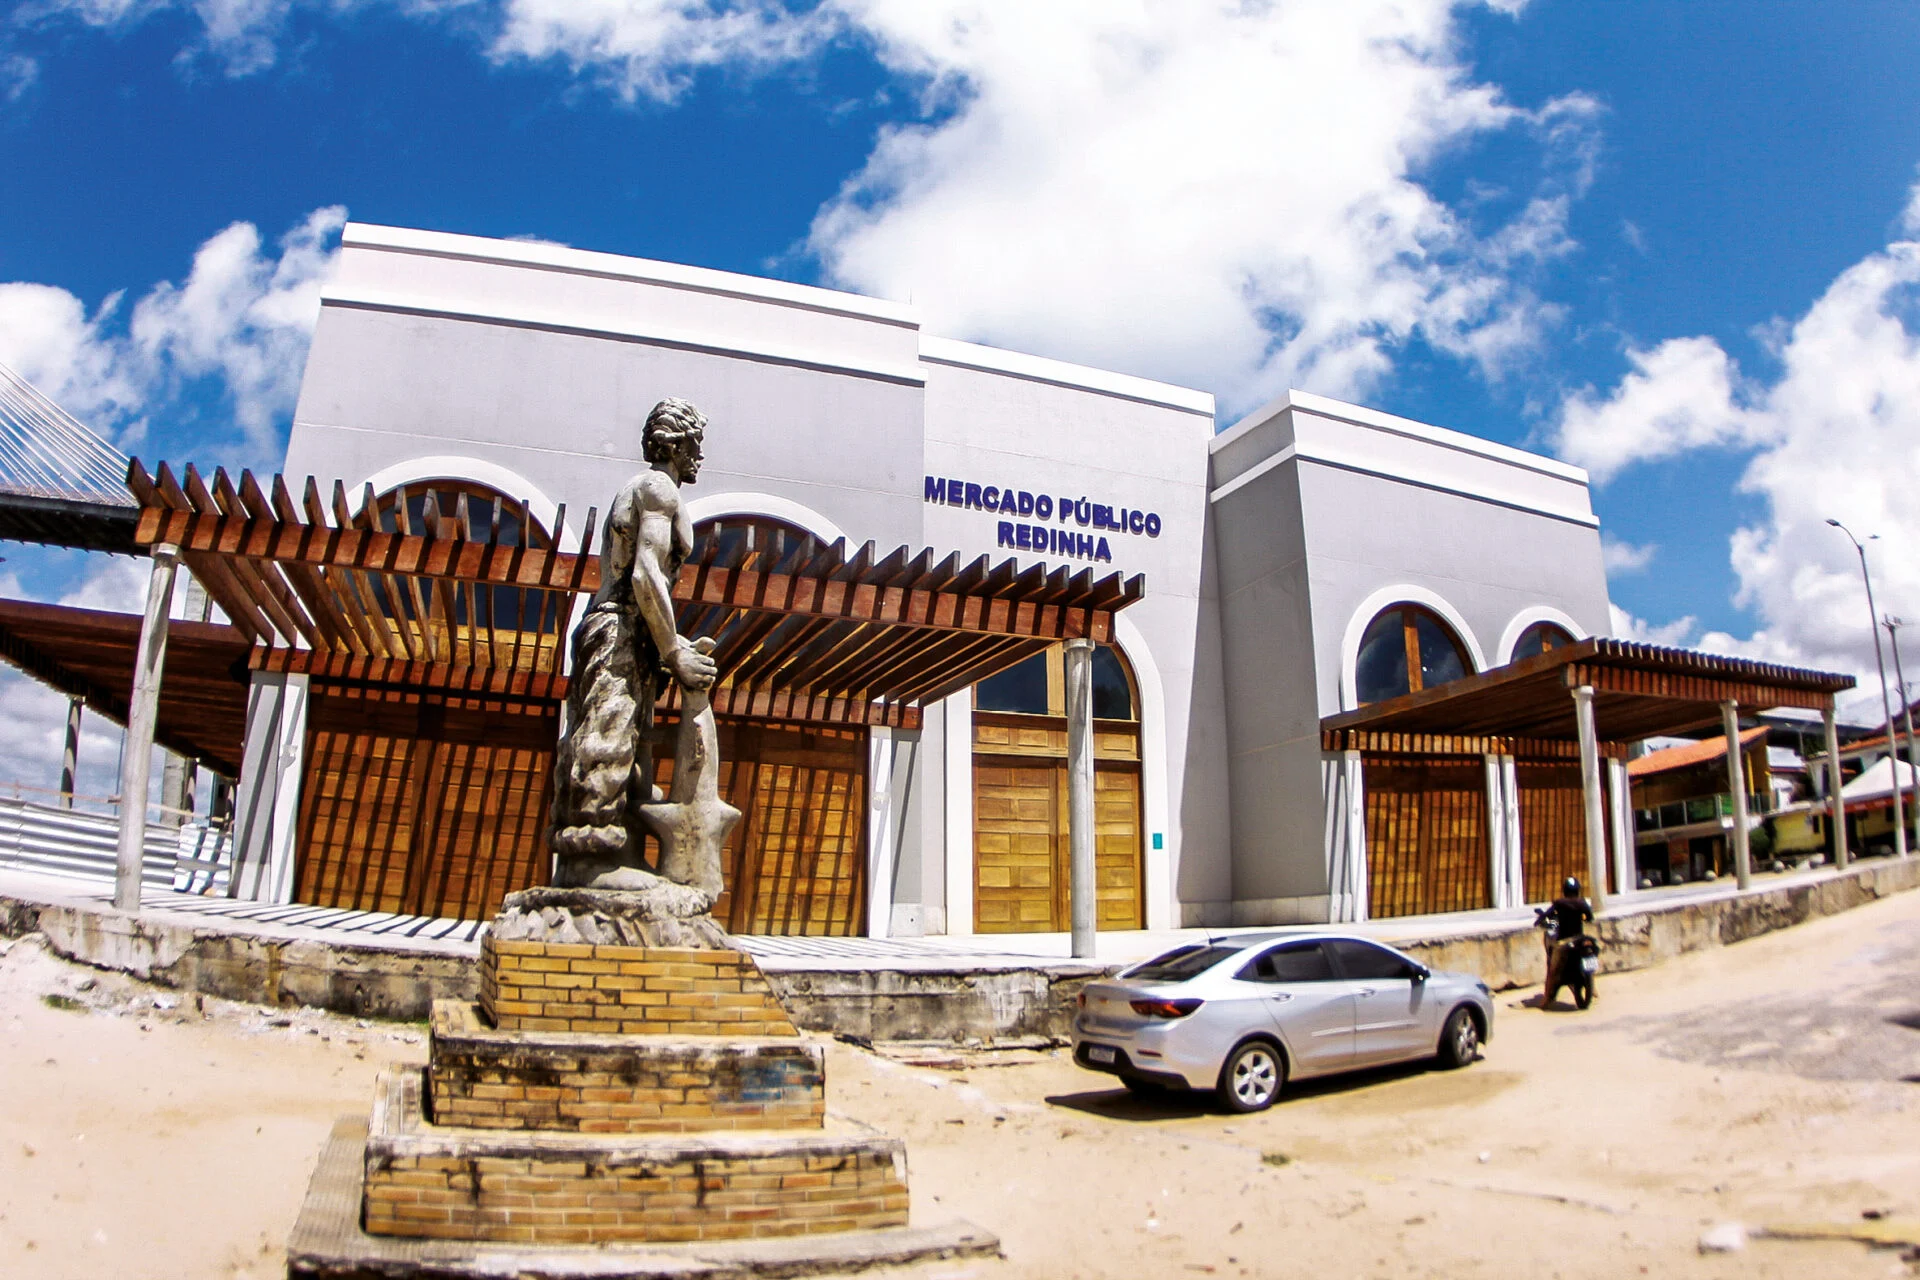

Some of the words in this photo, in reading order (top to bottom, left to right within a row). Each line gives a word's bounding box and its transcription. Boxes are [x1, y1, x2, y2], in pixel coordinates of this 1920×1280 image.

[924, 476, 1053, 519] MERCADO
[1059, 496, 1161, 537] PÚBLICO
[997, 521, 1112, 562] REDINHA
